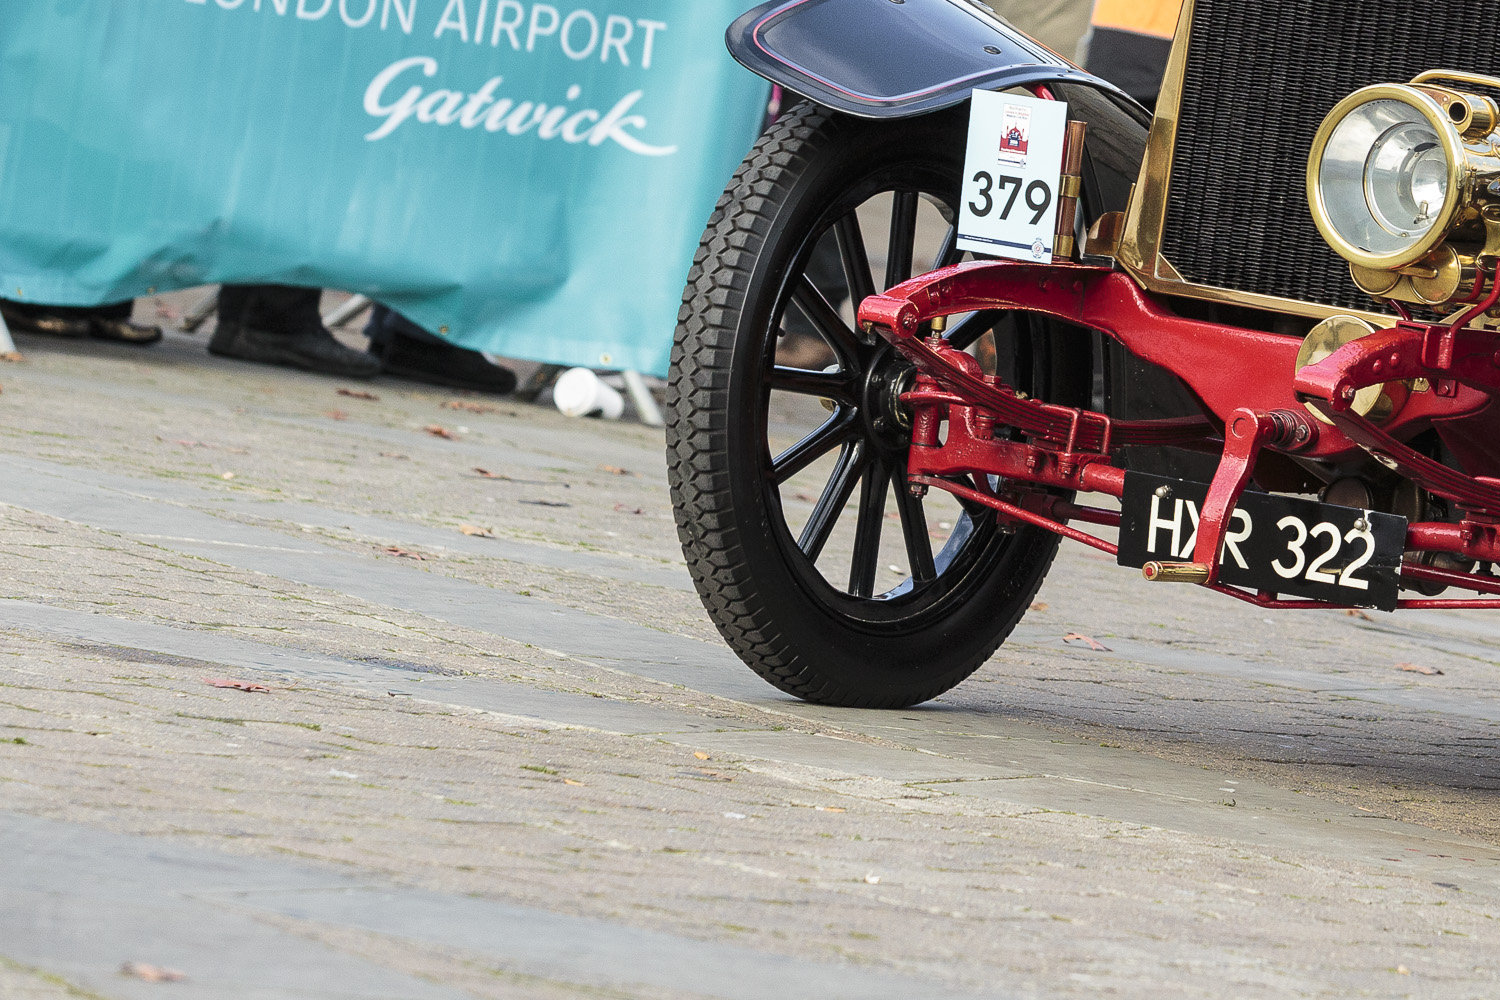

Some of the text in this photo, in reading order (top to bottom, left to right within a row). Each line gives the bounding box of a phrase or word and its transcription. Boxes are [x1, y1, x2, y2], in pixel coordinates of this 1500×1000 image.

[363, 55, 678, 157] Gatwick
[968, 170, 1051, 226] 379
[1271, 514, 1377, 591] 322
